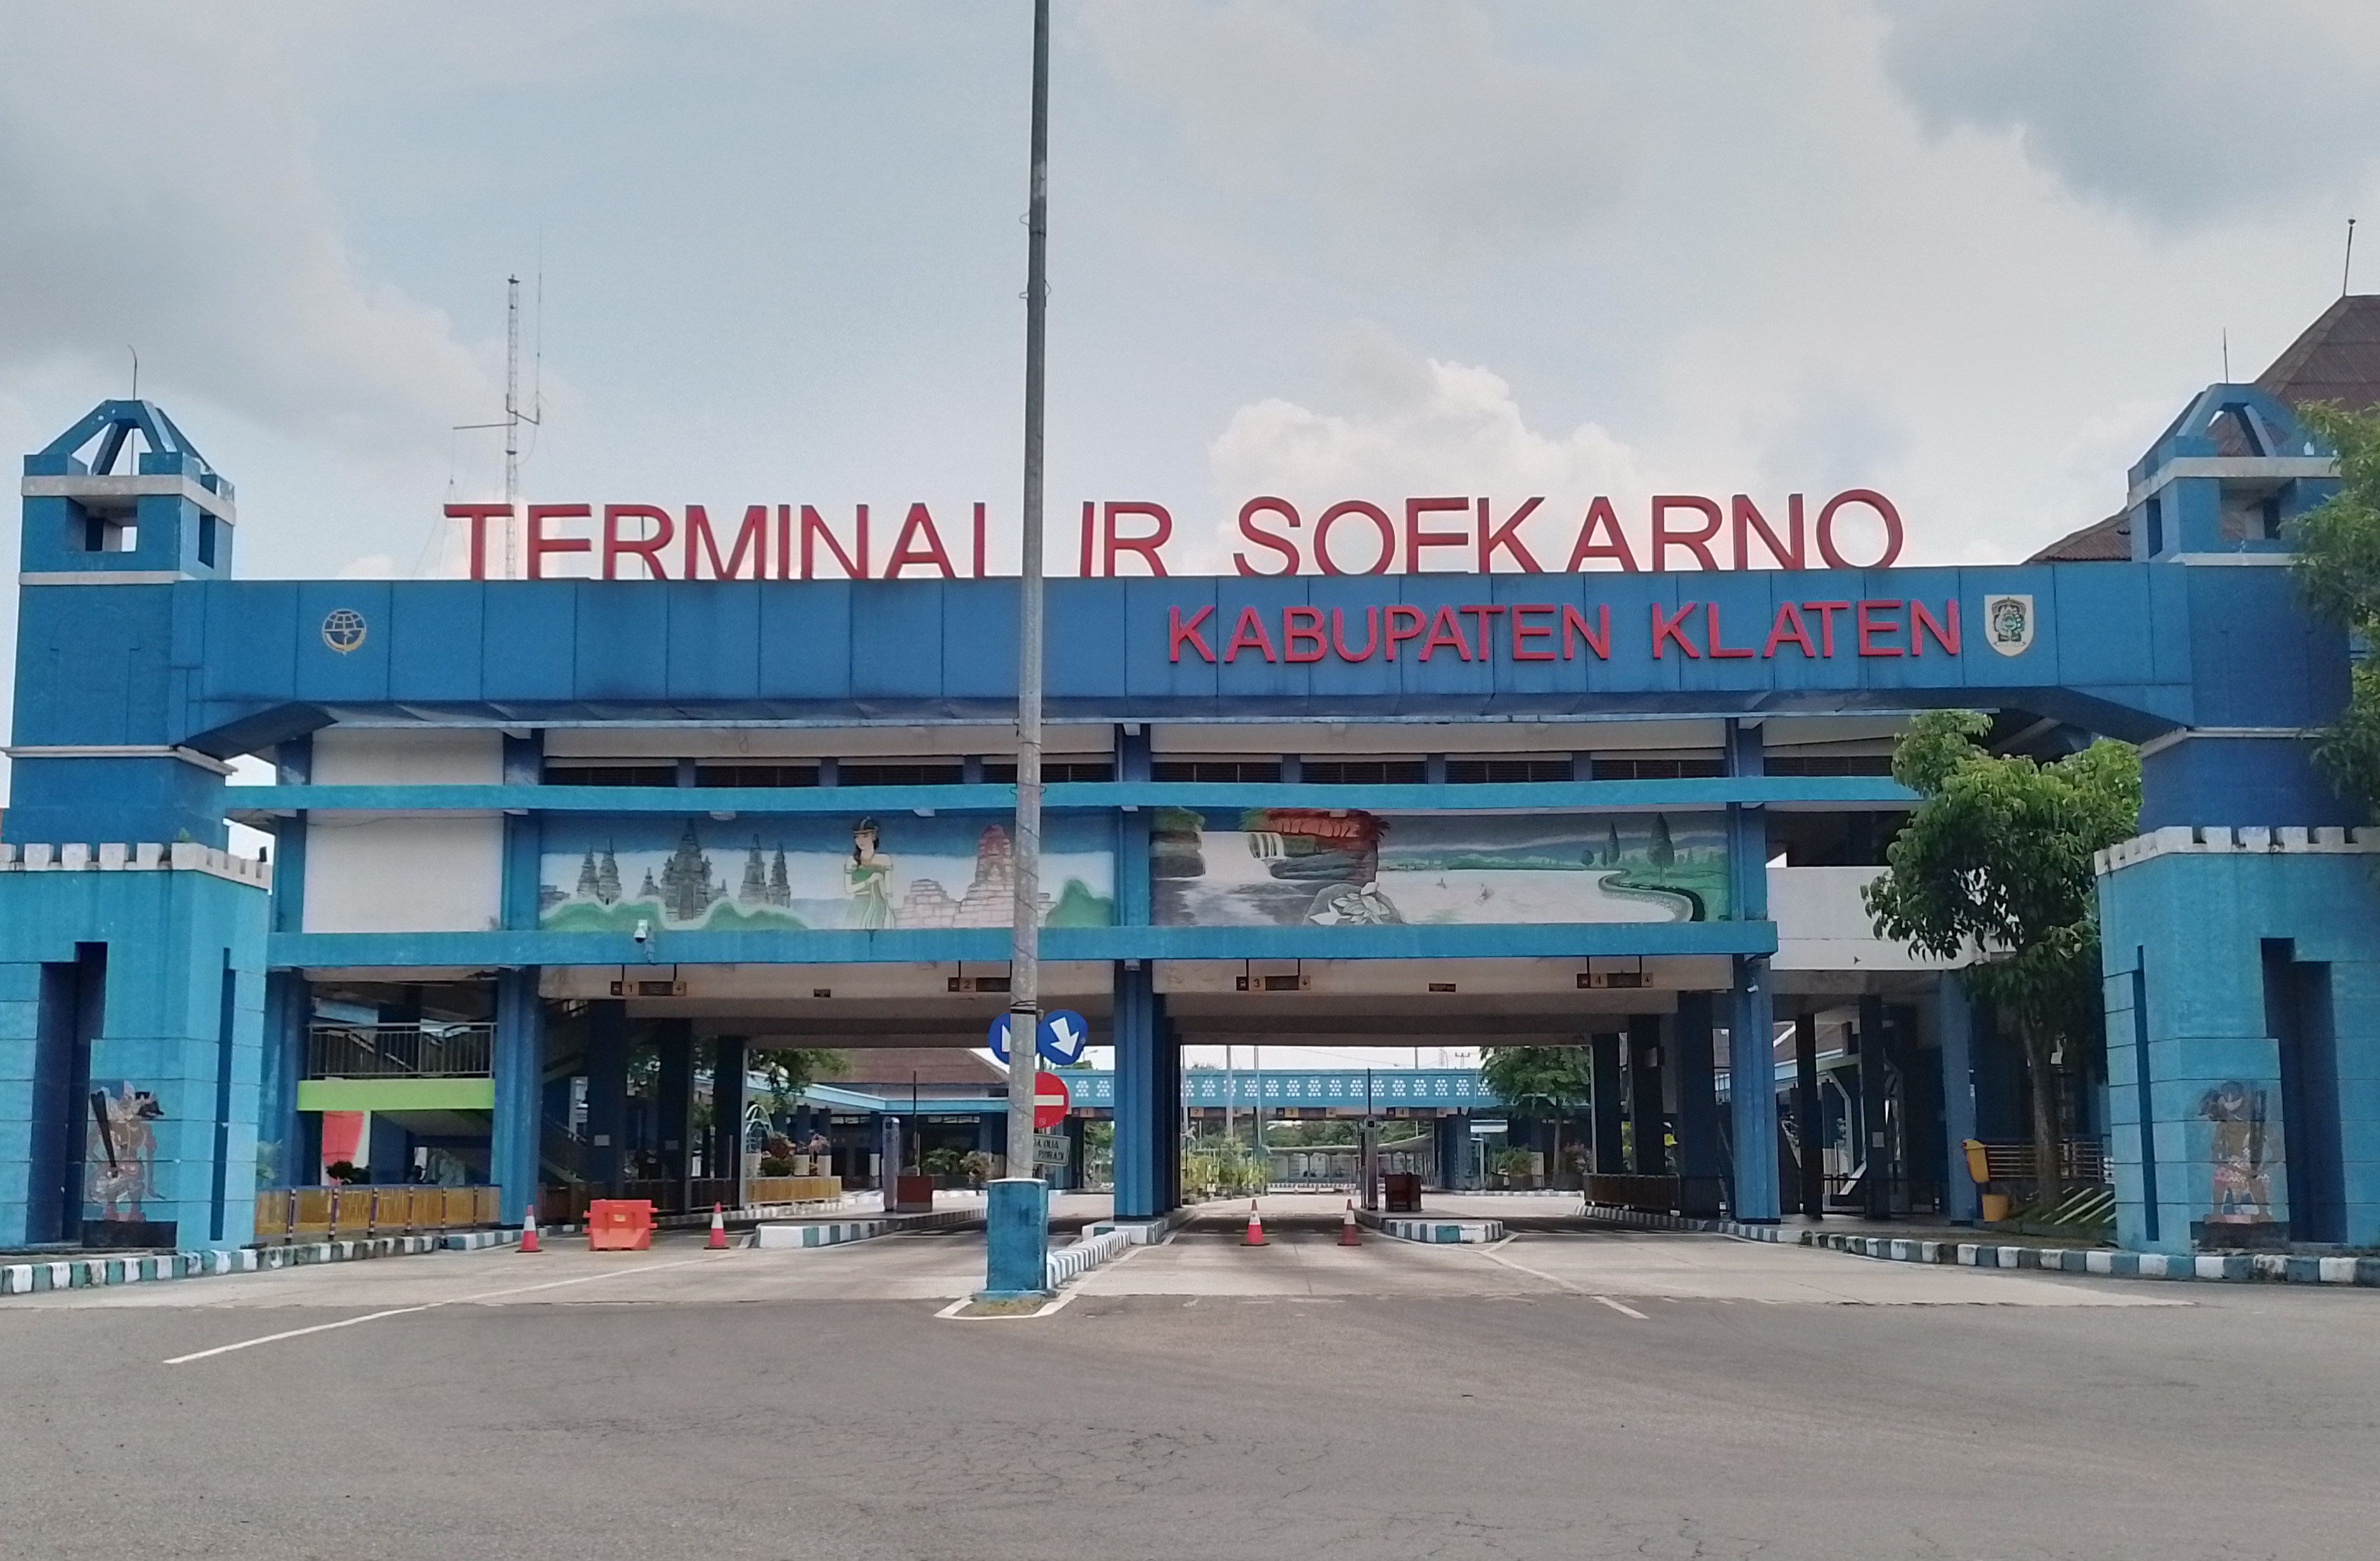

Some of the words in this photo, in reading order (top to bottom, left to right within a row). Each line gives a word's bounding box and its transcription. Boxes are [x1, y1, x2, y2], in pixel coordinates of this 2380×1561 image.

[443, 502, 985, 580] TERMINAL
[1079, 500, 1173, 578] IR
[1233, 489, 1904, 577] SOEKARNO
[1167, 604, 1611, 663] KABUPATEN
[1650, 599, 1961, 660] KLATEN
[964, 979, 972, 990] 2
[1253, 978, 1261, 988] 3
[1043, 1140, 1059, 1149] DUA
